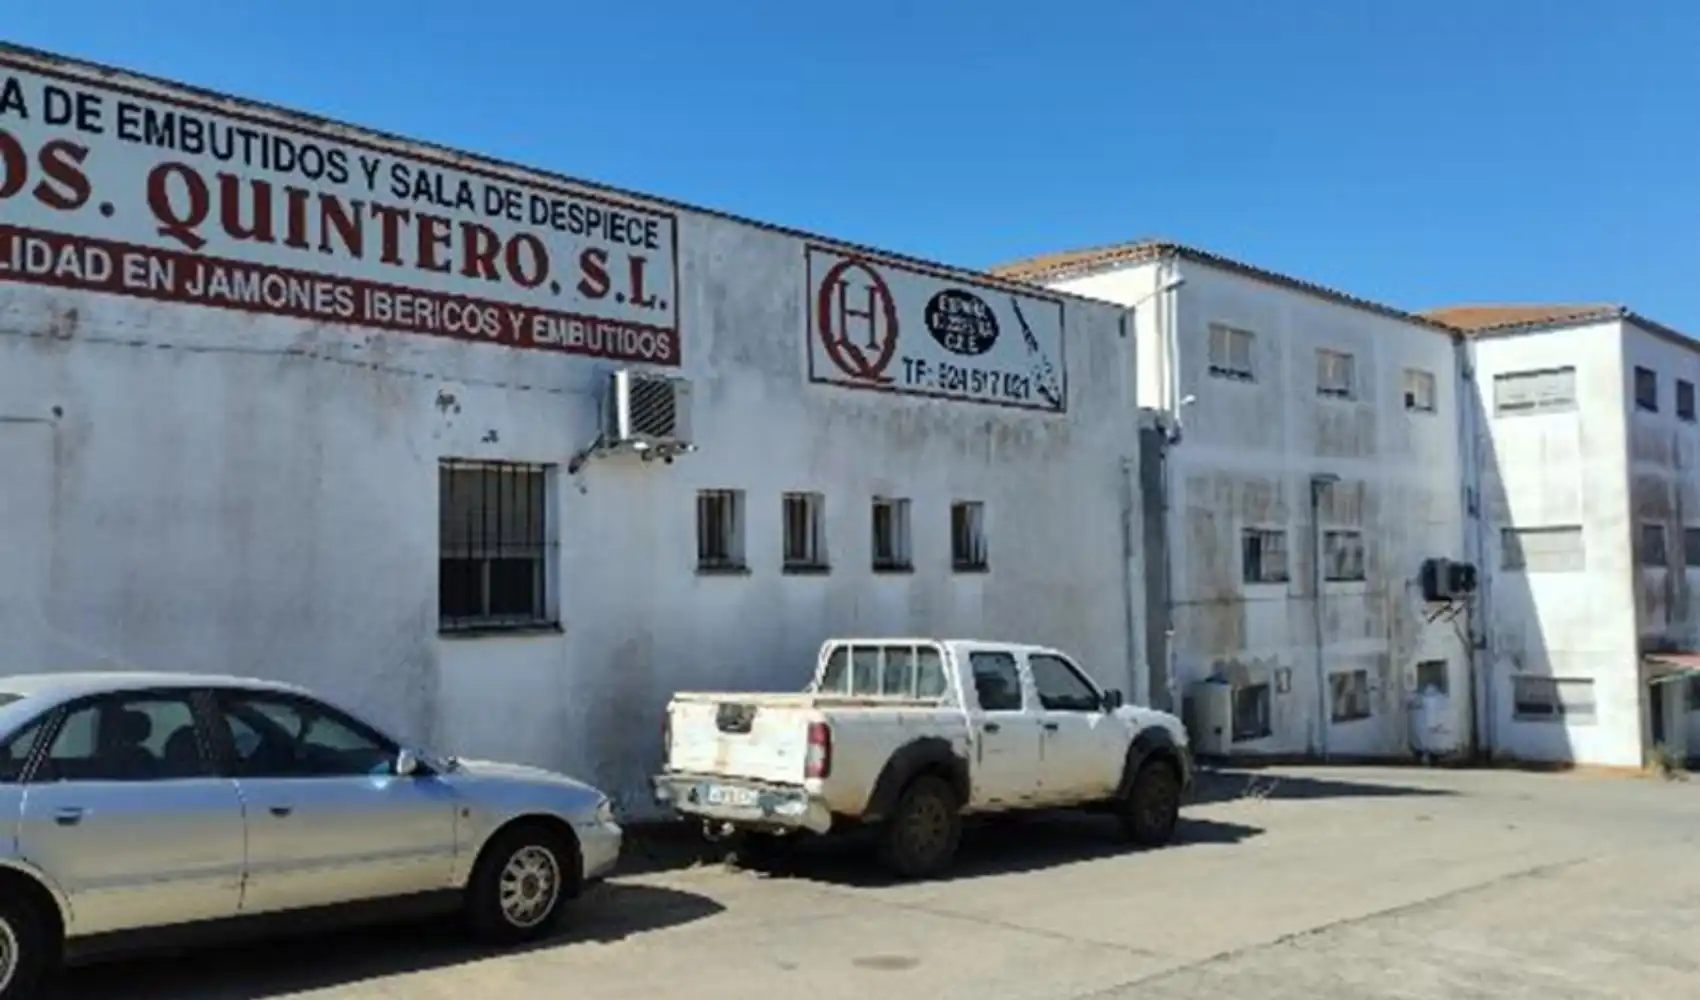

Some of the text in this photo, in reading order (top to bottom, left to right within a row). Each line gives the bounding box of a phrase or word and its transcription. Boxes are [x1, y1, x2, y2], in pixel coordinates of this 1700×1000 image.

[43, 85, 104, 133] DE
[116, 101, 349, 184] EMBUTIDOS
[359, 154, 381, 190] Y
[390, 161, 475, 213] SALA
[484, 184, 522, 222] DE
[529, 194, 660, 250] DESPIECE
[0, 236, 113, 282] IDAD
[122, 251, 174, 292] EN
[185, 264, 354, 317] JAMONES
[508, 311, 525, 340] Y
[531, 315, 671, 361] EMBUTIDOS
